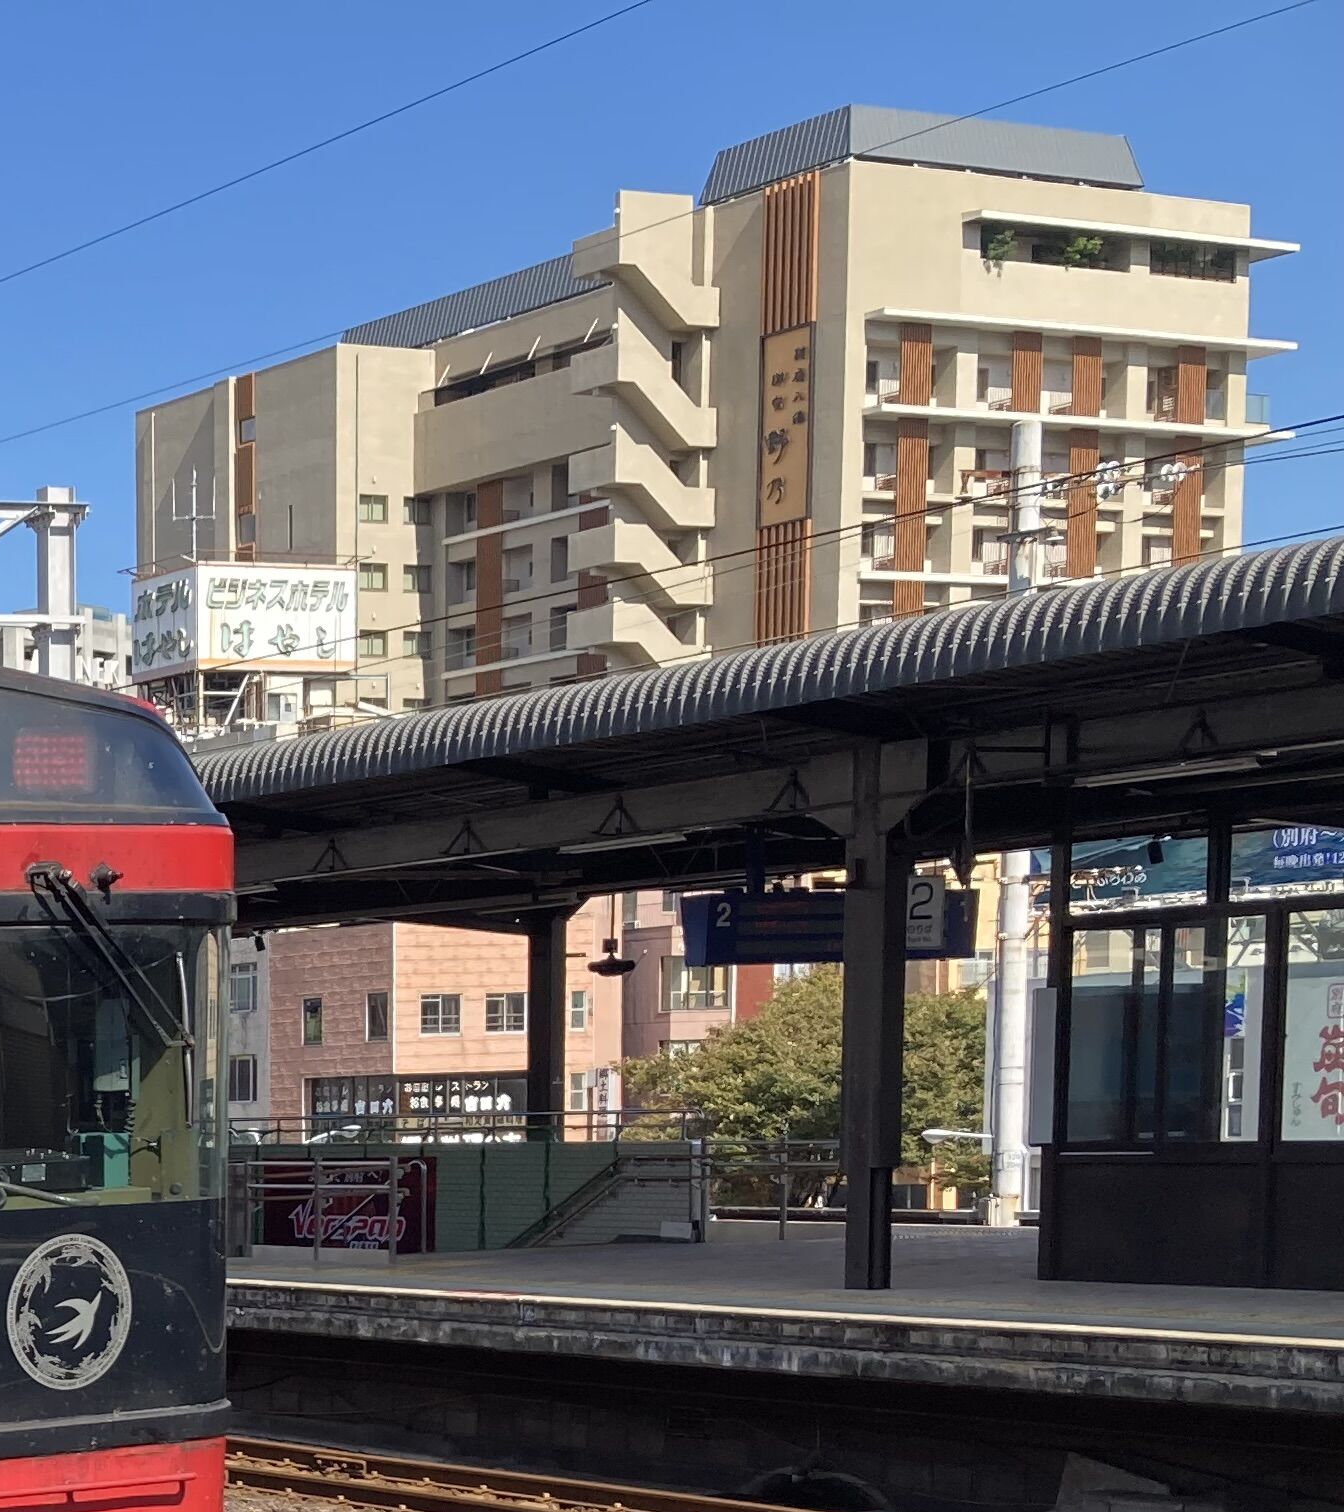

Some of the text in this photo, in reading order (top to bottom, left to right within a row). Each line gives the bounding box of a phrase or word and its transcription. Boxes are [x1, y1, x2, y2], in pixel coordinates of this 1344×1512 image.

[134, 578, 193, 622] ホテル
[206, 577, 349, 613] ビジネスホテル
[133, 627, 195, 667] はやし
[221, 619, 336, 659] はやし
[716, 902, 731, 927] 2
[909, 881, 934, 920] 2
